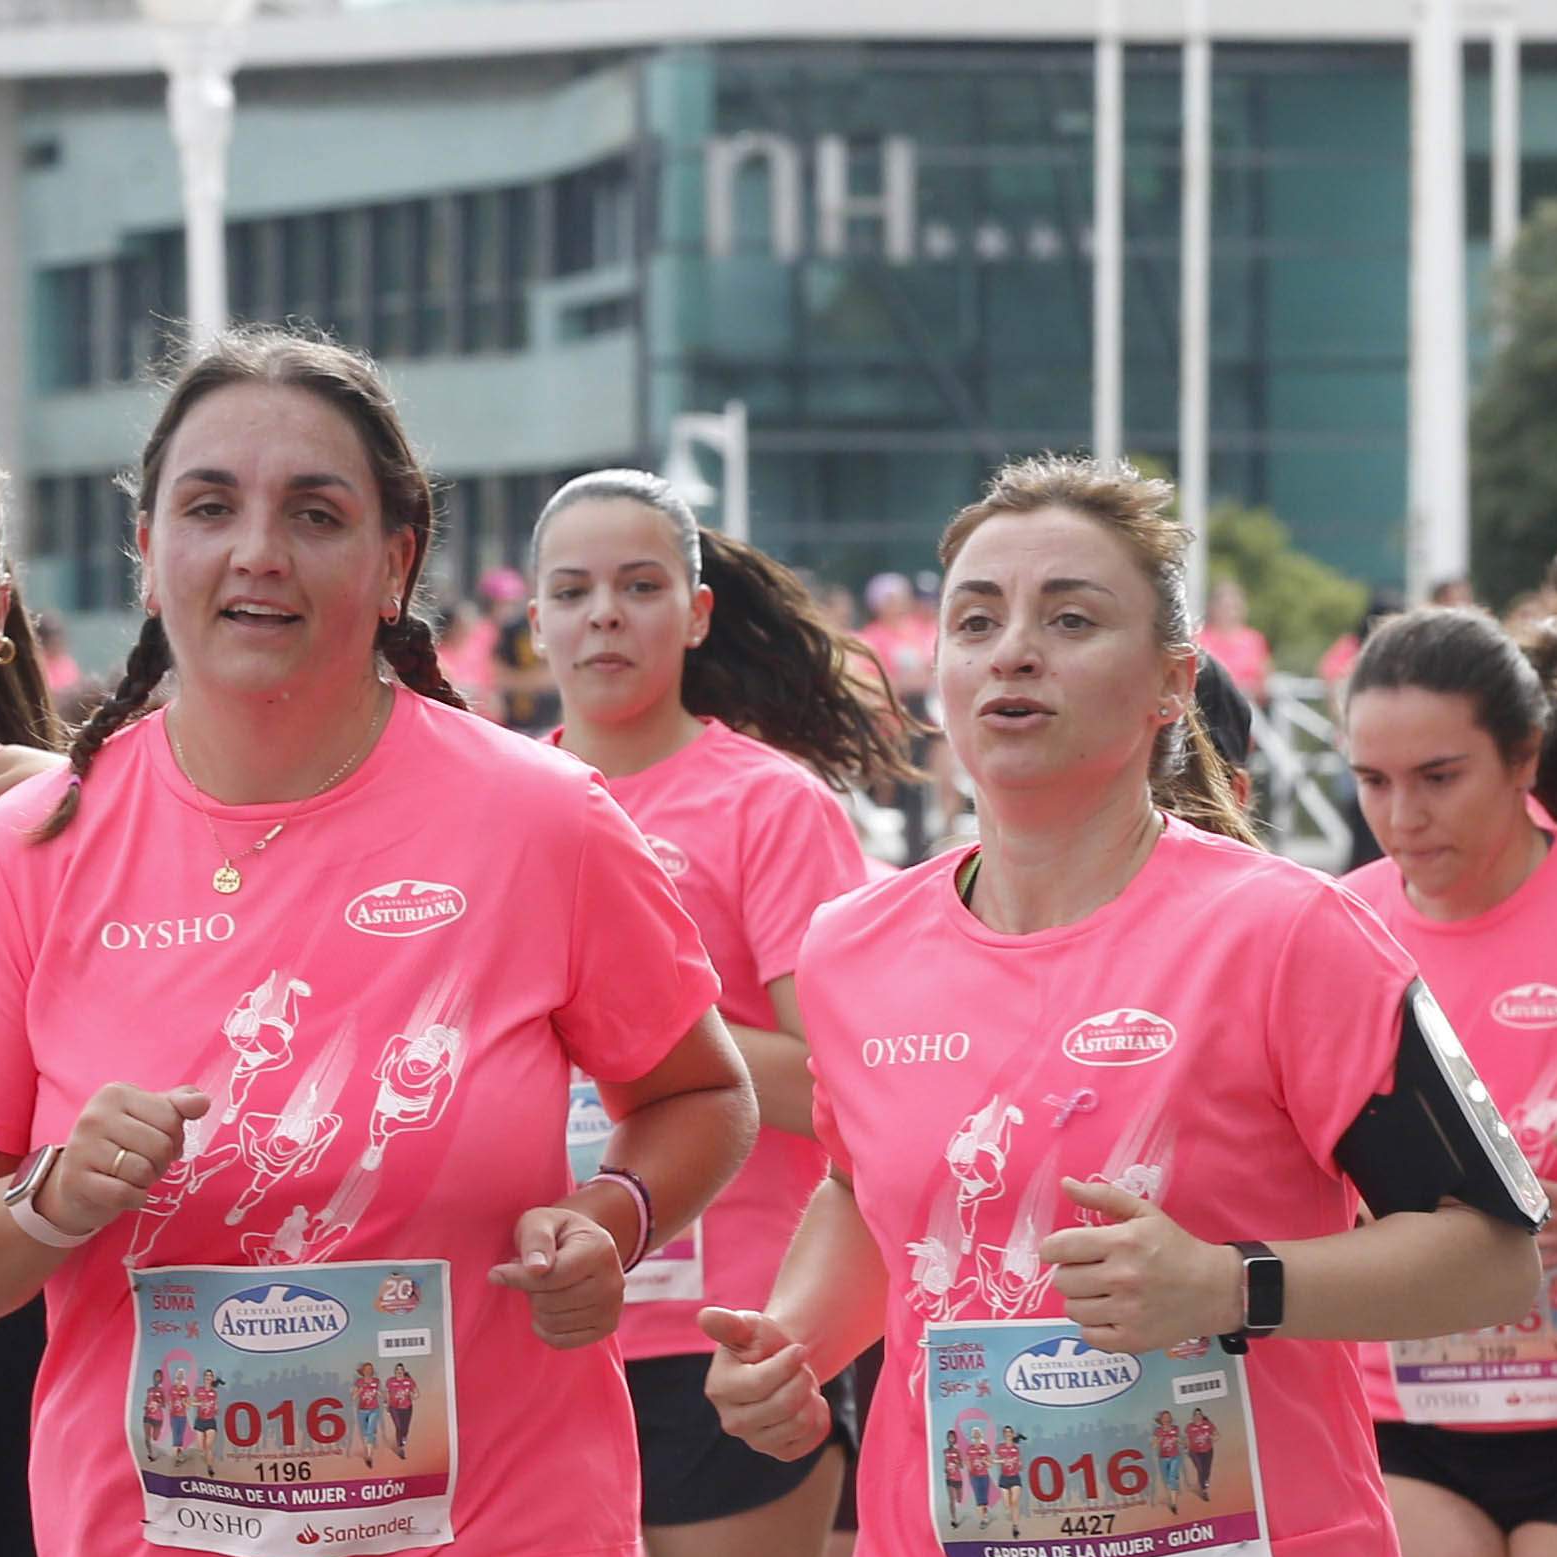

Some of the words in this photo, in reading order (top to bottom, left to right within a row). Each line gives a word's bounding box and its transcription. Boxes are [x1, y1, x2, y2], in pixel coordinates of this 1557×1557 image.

[100, 912, 236, 949] OYSHO
[861, 1031, 971, 1067] OYSHO
[220, 1310, 340, 1335] ASTURIANA
[938, 1353, 986, 1371] SUMA
[1014, 1364, 1134, 1391] ASTURIANA
[224, 1397, 347, 1447] 016
[254, 1461, 312, 1482] 1196
[1028, 1449, 1149, 1502] 016
[180, 1480, 243, 1502] CARRERA
[246, 1487, 263, 1504] DE
[268, 1489, 288, 1505] LA
[292, 1486, 347, 1505] MUJER
[361, 1480, 405, 1500] GIJÓN
[177, 1506, 263, 1539] OYSHO
[323, 1514, 414, 1544] Santander
[1060, 1513, 1116, 1536] 4427
[1100, 1534, 1155, 1557] MUJER
[1167, 1522, 1215, 1548] GIJÓN
